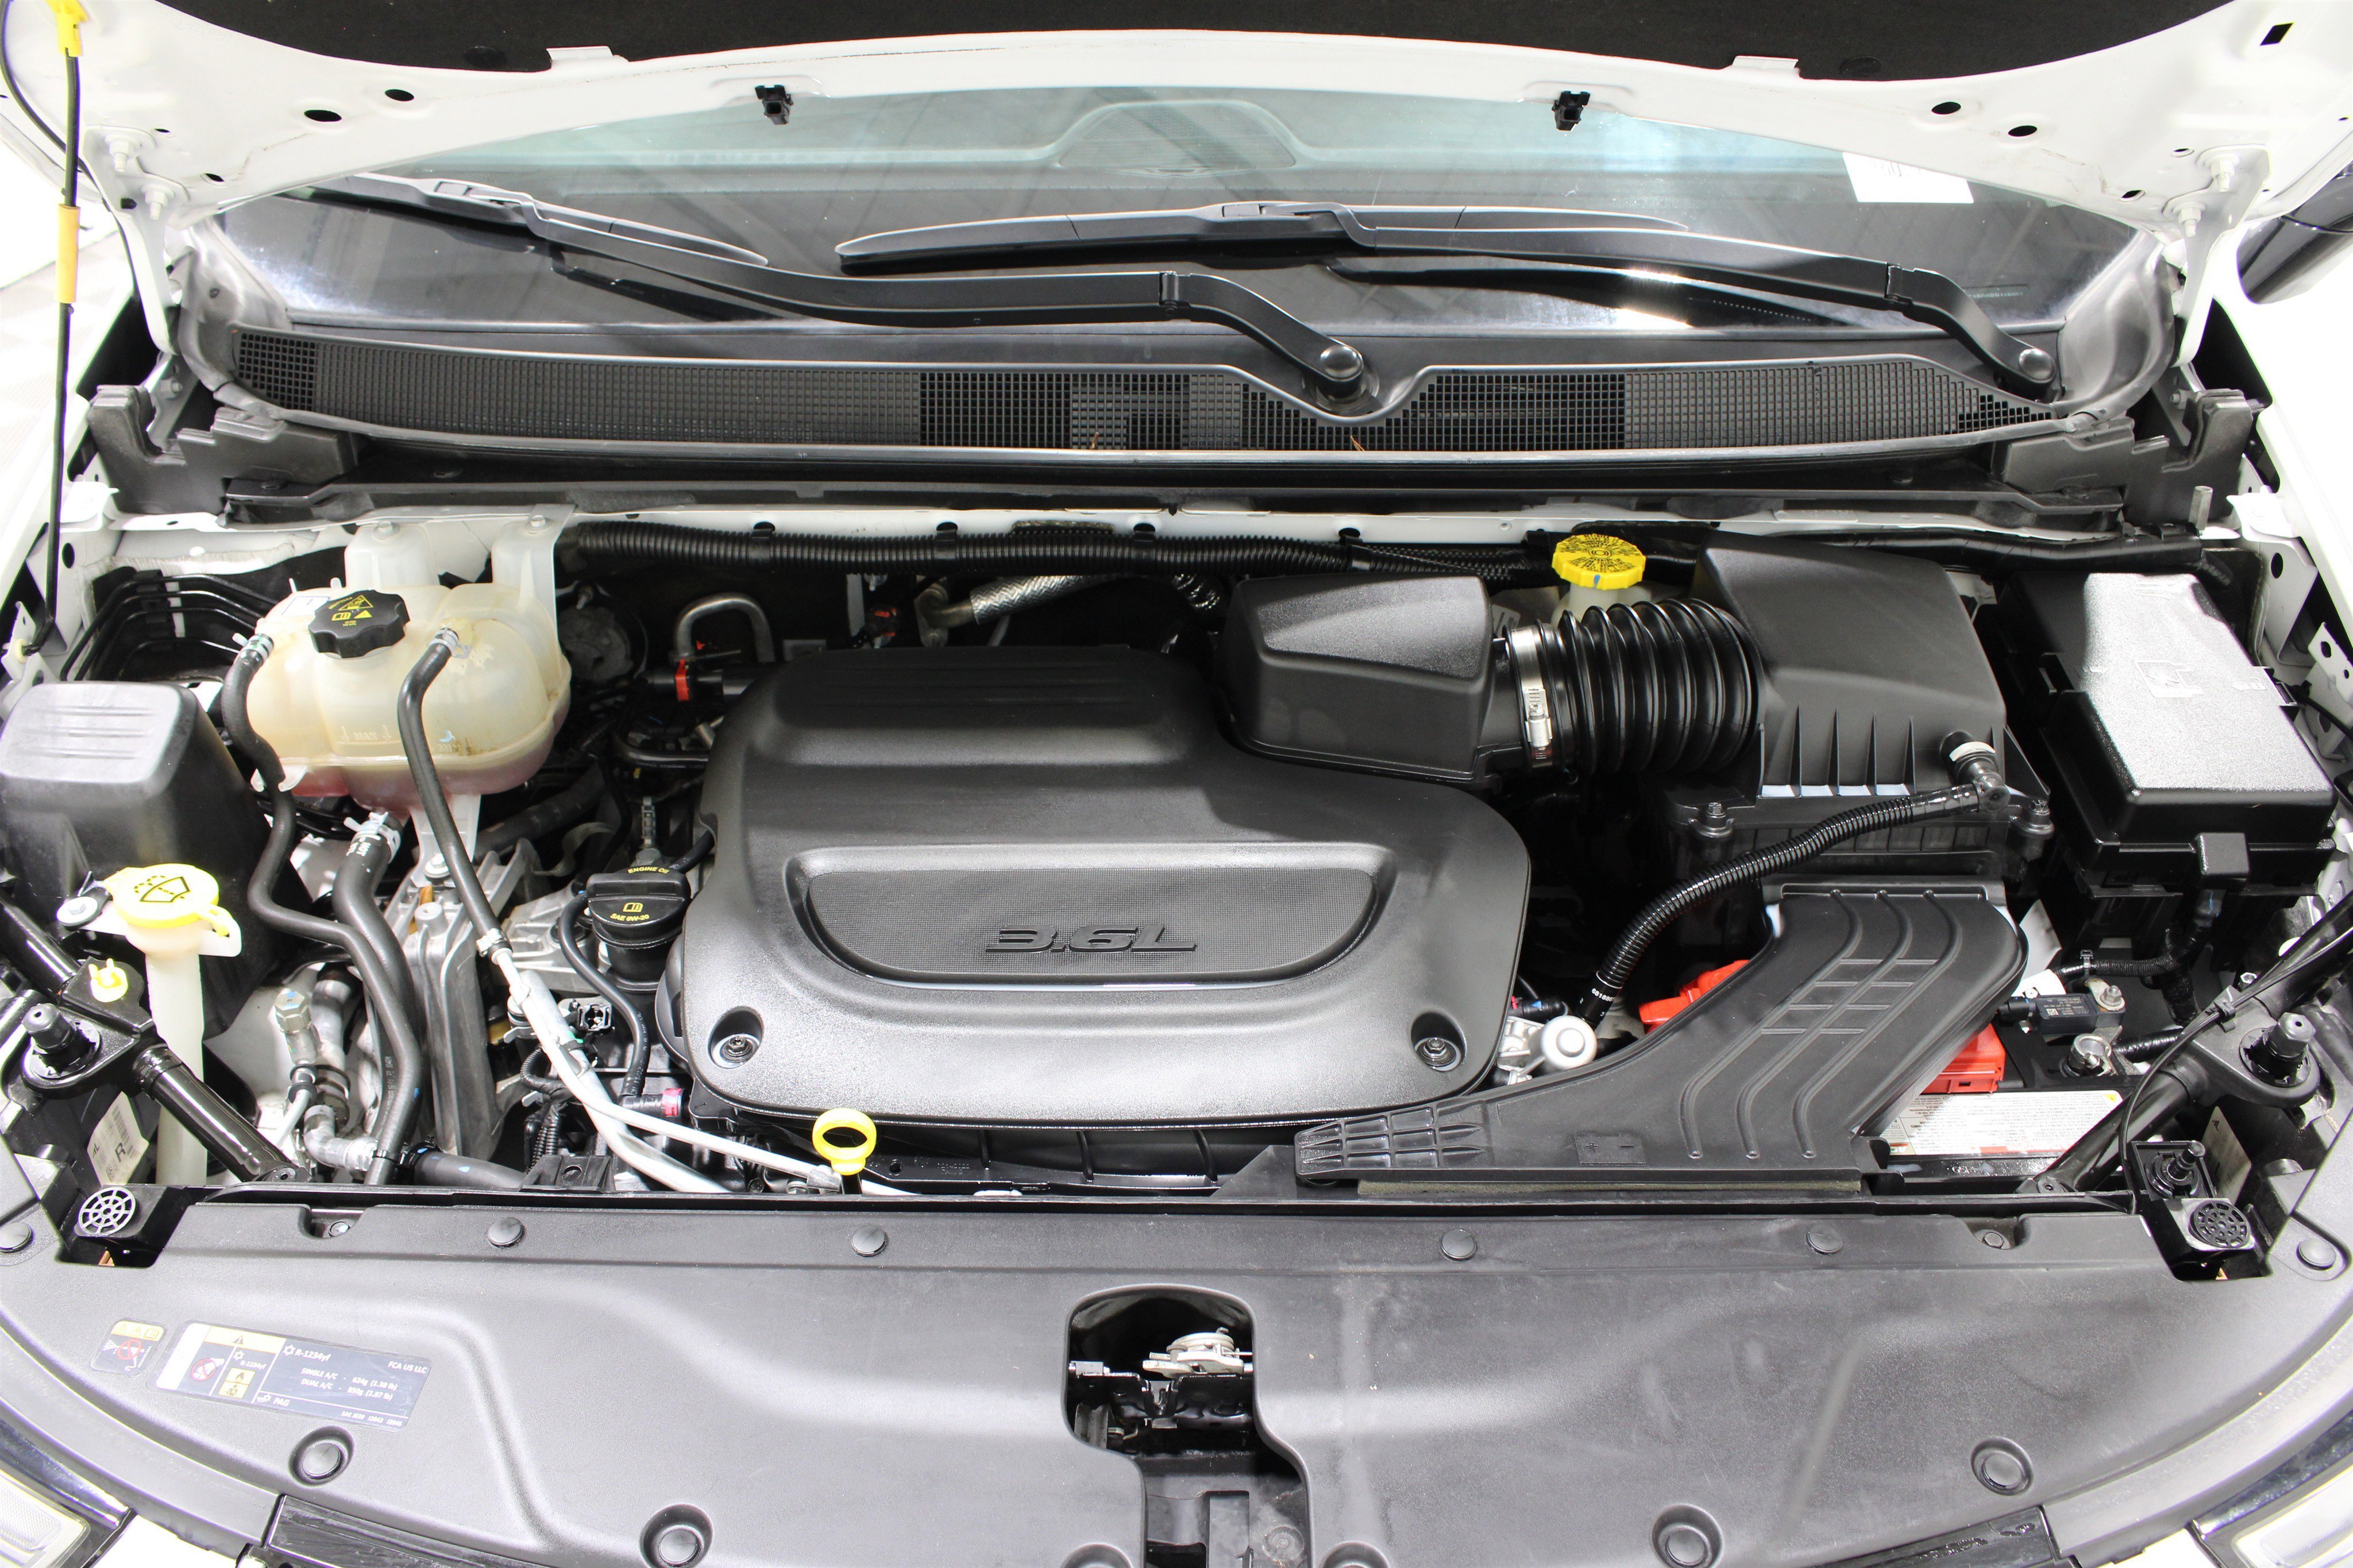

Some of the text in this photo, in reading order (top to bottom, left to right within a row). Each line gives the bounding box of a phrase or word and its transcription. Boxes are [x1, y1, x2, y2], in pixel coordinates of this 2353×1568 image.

[985, 924, 1198, 953] 3.6L
[295, 1348, 331, 1362] R-1234yf
[388, 1361, 427, 1374] FCA US LLC
[301, 1367, 325, 1378] SINGLE
[324, 1372, 338, 1380] A/C
[352, 1377, 369, 1387] 624g
[300, 1378, 320, 1388] DUAL
[320, 1381, 334, 1390] A/C
[273, 1396, 290, 1407] PAG
